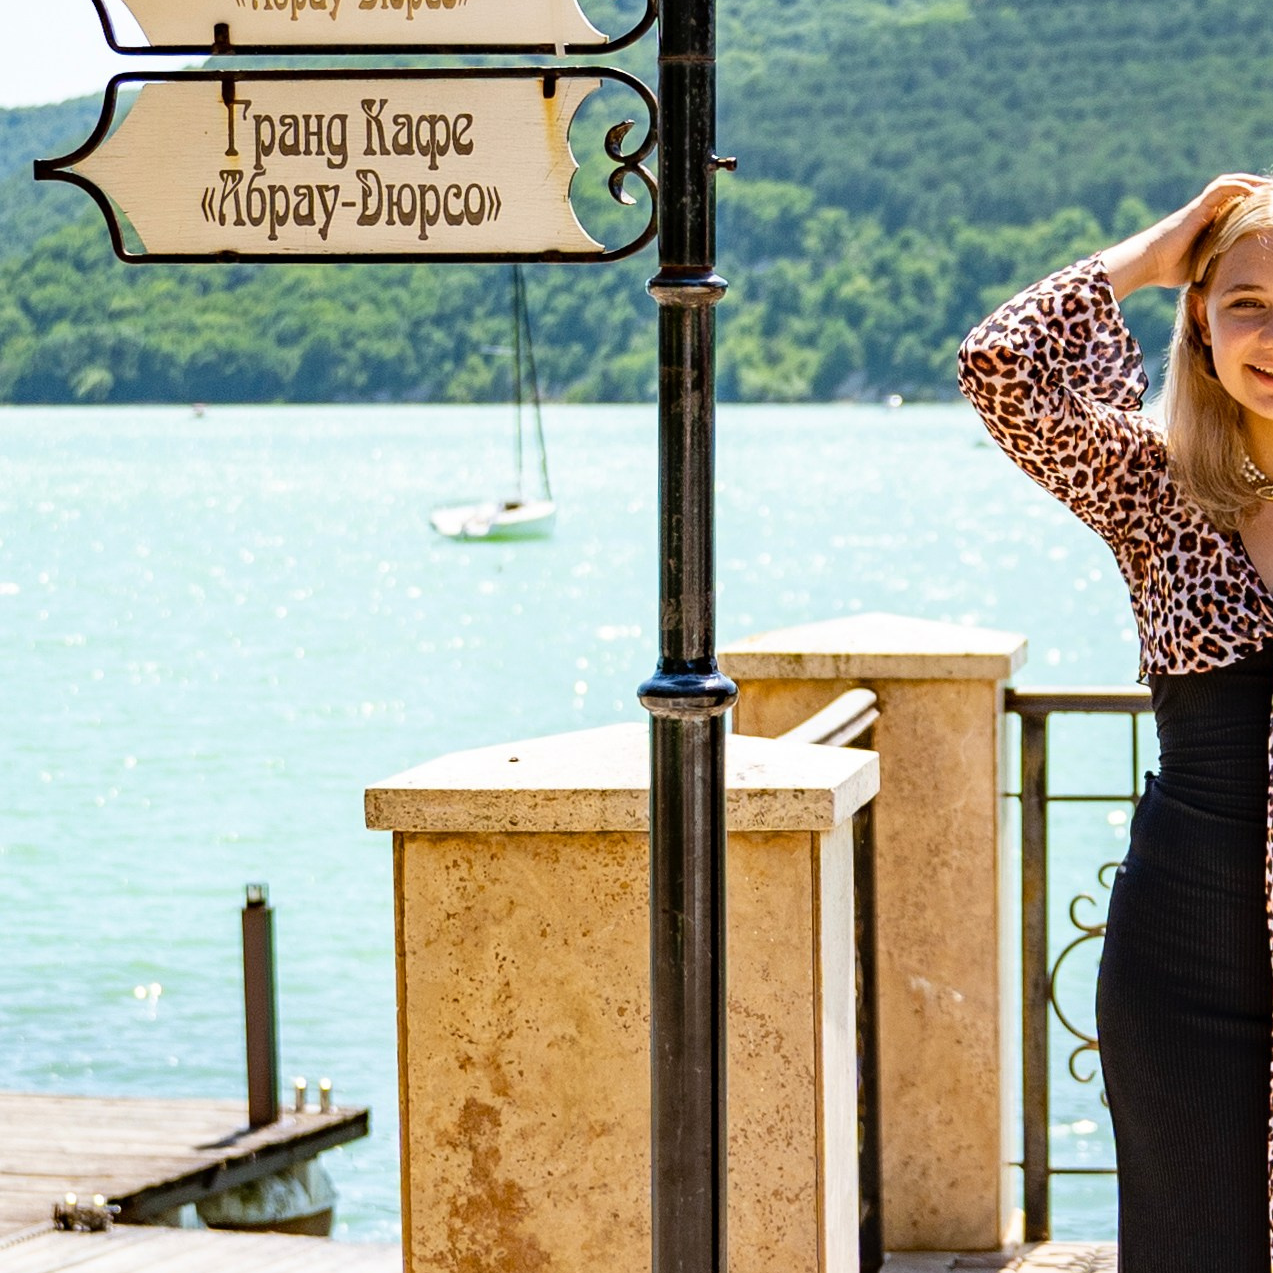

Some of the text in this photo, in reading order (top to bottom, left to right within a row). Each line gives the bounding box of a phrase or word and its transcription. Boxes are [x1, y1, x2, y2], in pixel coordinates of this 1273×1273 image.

[223, 98, 475, 171] Гранд Кафе
[200, 168, 502, 242] «Абрау-Дюрсо»
